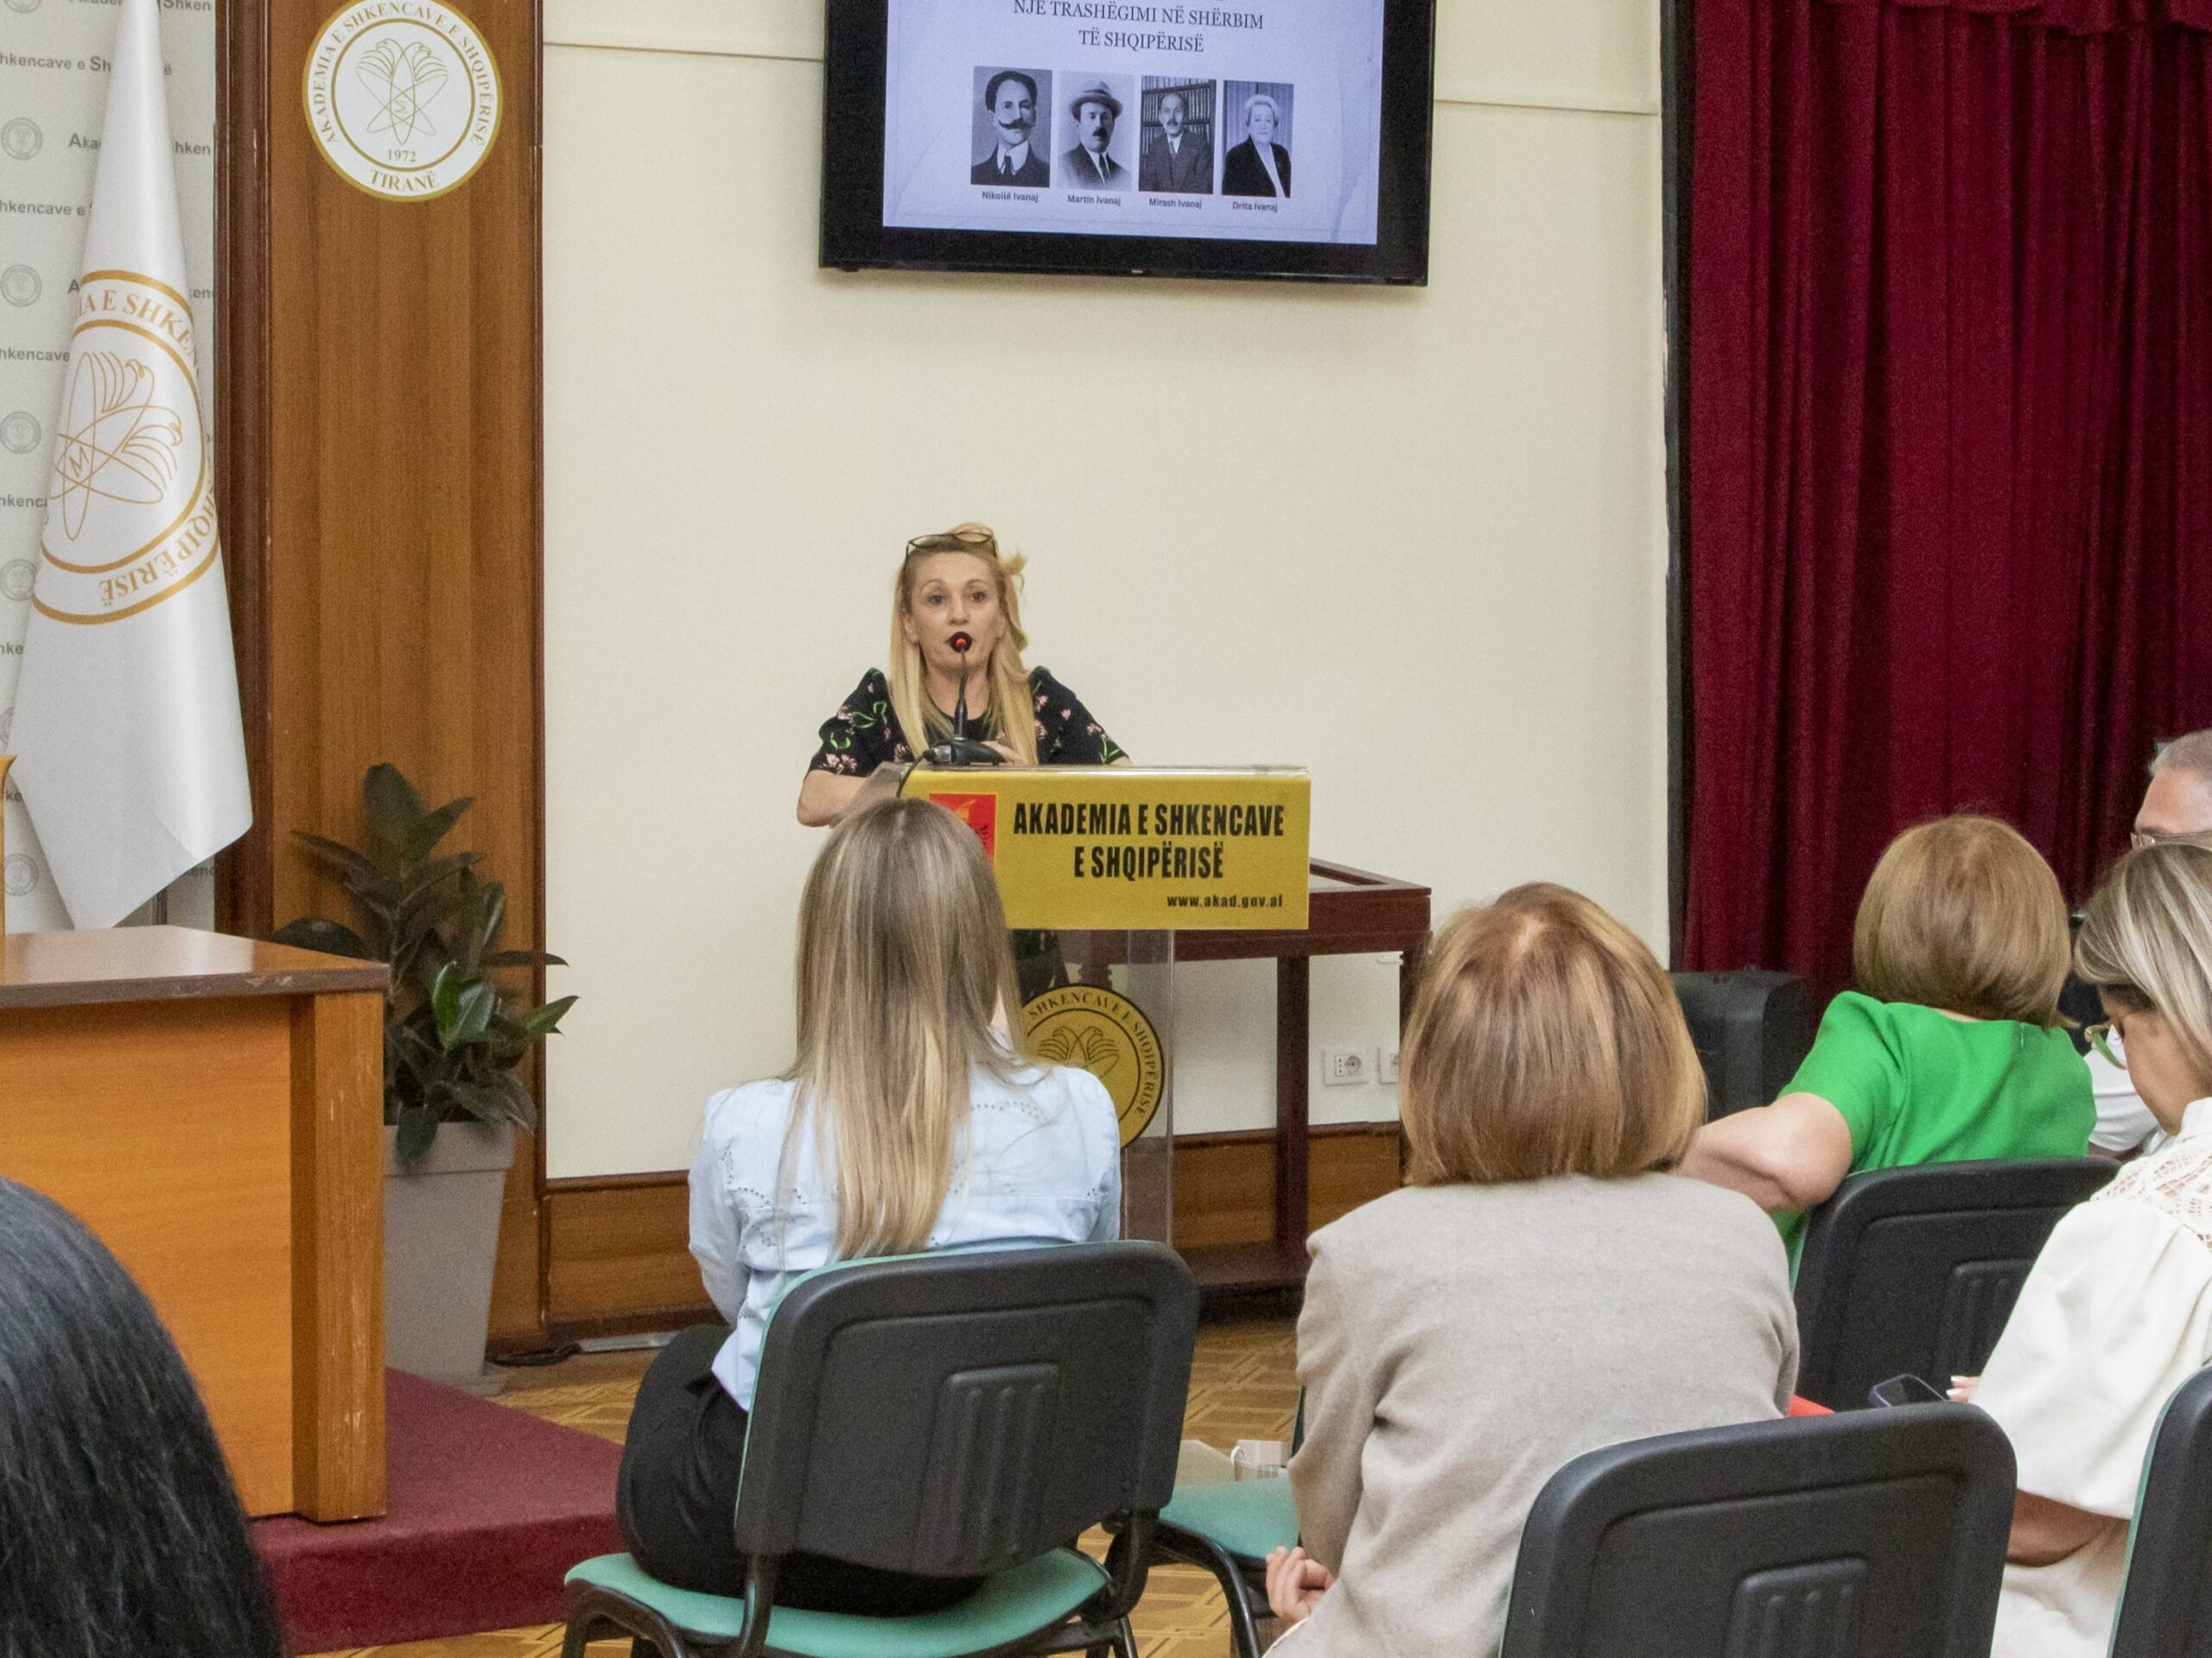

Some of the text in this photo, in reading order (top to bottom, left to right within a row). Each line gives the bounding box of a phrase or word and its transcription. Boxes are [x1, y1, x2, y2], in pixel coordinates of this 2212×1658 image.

[1050, 0, 1157, 22] TRASHËGIMI
[1161, 5, 1185, 24] NË
[1188, 8, 1264, 29] SHËRBIM
[1079, 28, 1205, 52] TË SHQIPËRISË
[313, 46, 340, 144] AKADEMIA
[332, 31, 346, 44] E
[342, 2, 448, 34] SHKENCAVE
[448, 24, 461, 36] E
[388, 149, 416, 162] 1972
[371, 168, 441, 192] TIRANË
[1014, 192, 1039, 203] Ivanaj
[1067, 194, 1122, 206] Martin Ivanaj
[1149, 198, 1203, 210] Mirash Ivanaj
[1232, 201, 1278, 213] Drita Ivanaj
[1013, 803, 1285, 836] AKADEMIA E SHKENCAVE
[1074, 841, 1224, 881] E SHQIPËRISË
[1166, 894, 1283, 908] www.akad.gov.al
